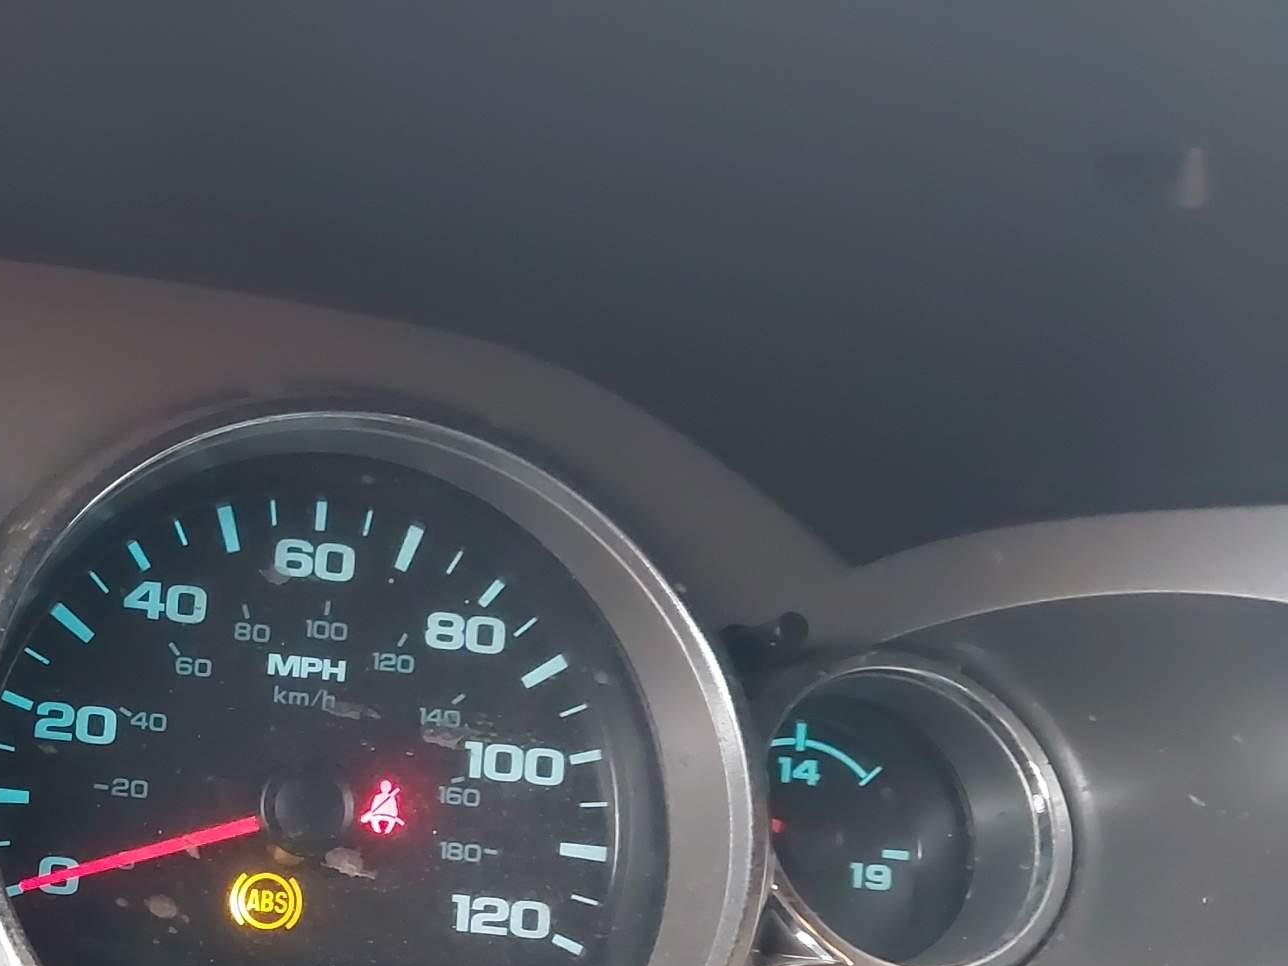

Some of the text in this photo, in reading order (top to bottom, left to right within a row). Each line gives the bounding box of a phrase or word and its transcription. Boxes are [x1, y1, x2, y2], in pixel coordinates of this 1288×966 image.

[274, 538, 356, 583] 60
[122, 580, 208, 625] 40
[233, 622, 271, 643] 80
[305, 619, 349, 641] 100
[425, 610, 506, 656] 80
[175, 655, 213, 678] 60
[267, 652, 347, 683] MPH
[372, 652, 415, 674] 120
[273, 686, 337, 711] km/h
[34, 702, 118, 745] 20
[129, 712, 168, 733] 40
[419, 707, 461, 729] 140
[464, 740, 564, 787] 100
[777, 757, 822, 786] 14
[110, 777, 149, 799] 20
[438, 785, 481, 807] 160
[439, 841, 481, 865] 180
[849, 863, 892, 891] 19
[246, 888, 289, 914] ABS
[450, 893, 552, 940] 120
